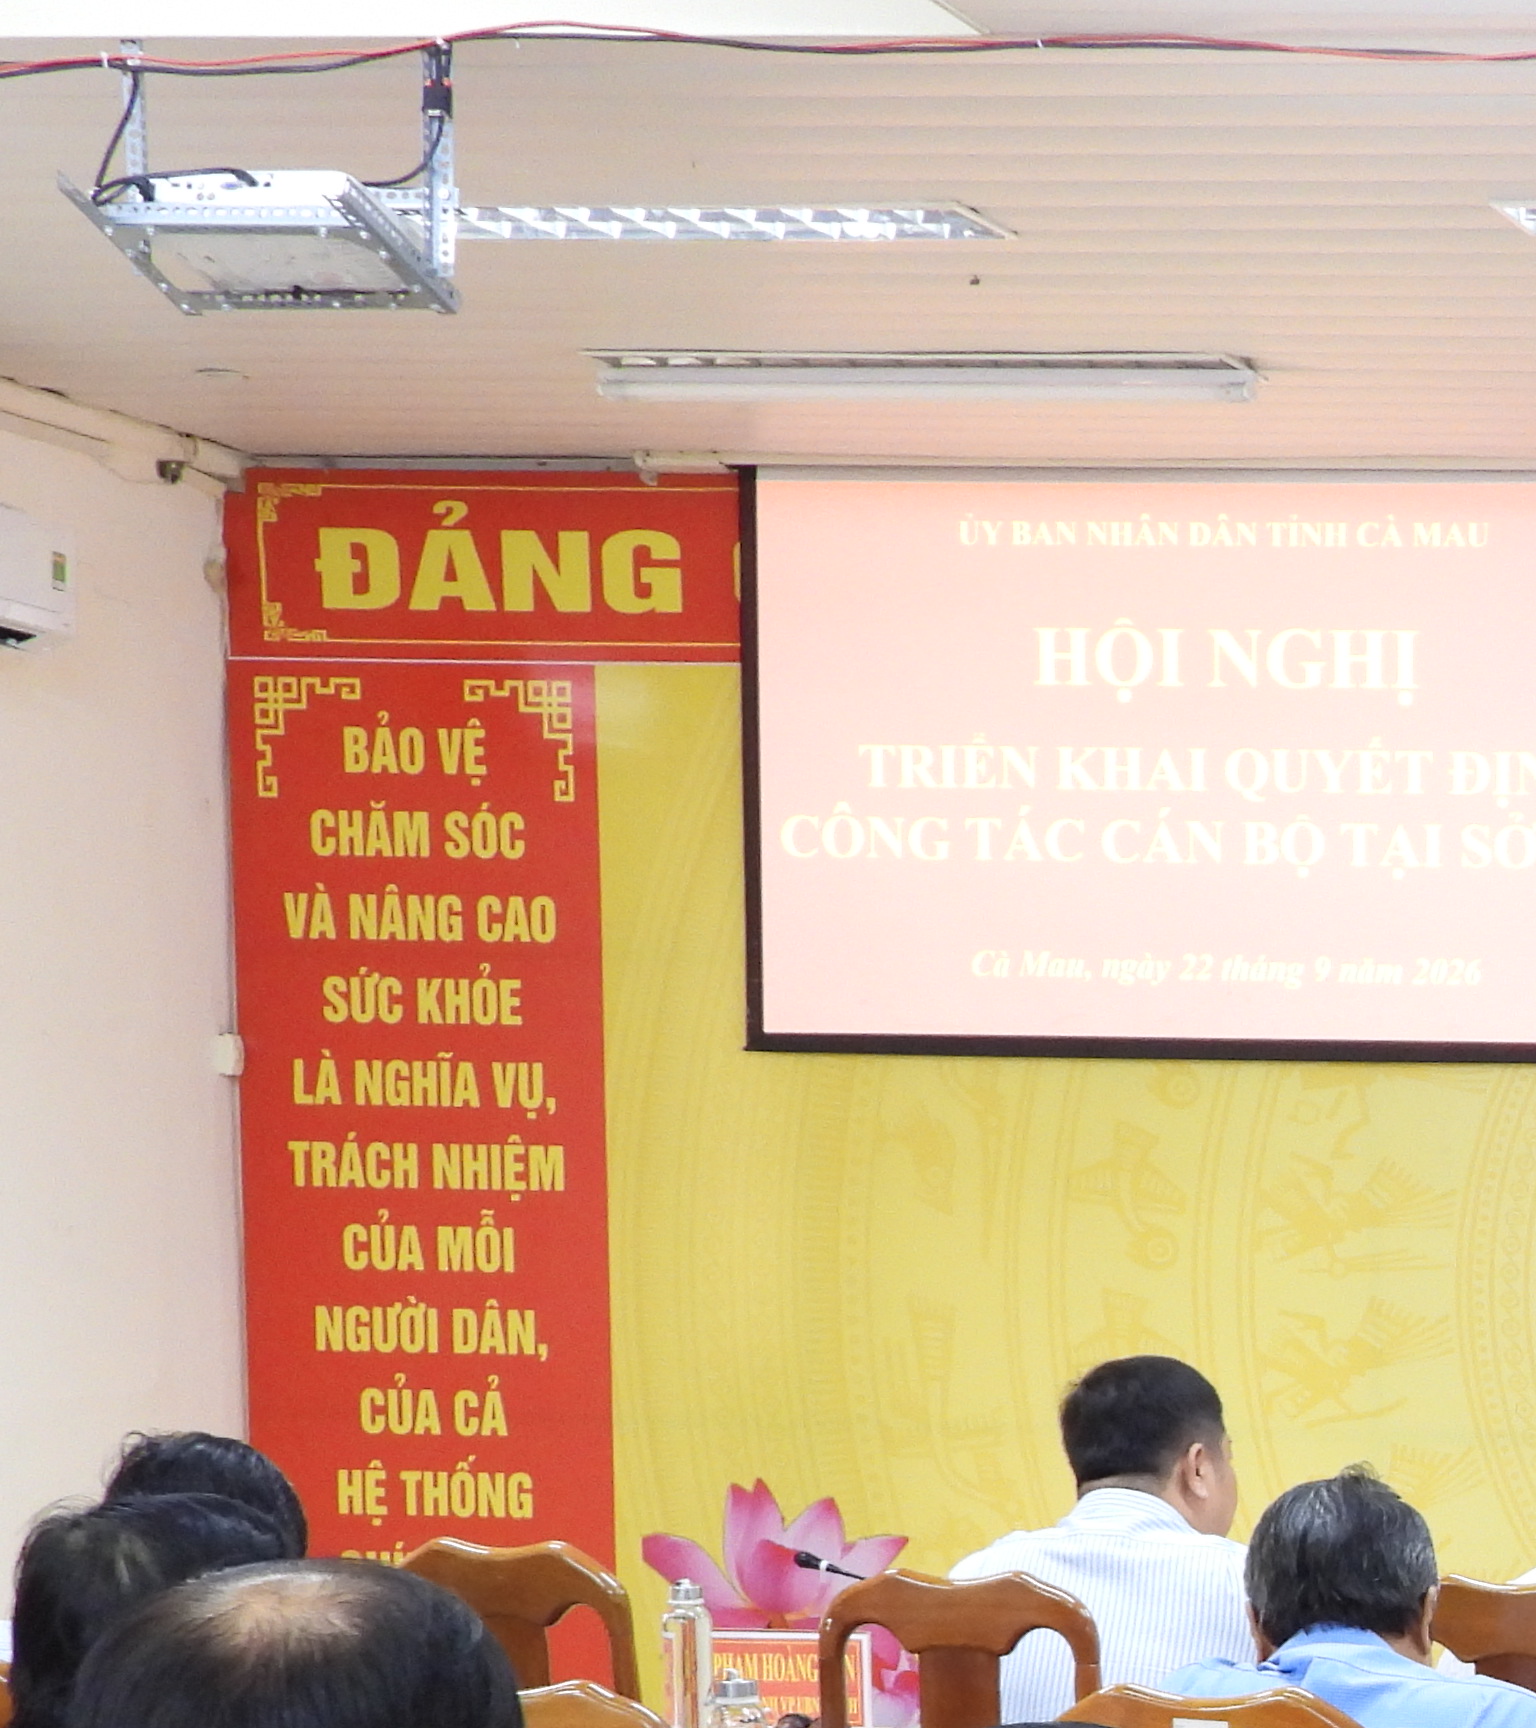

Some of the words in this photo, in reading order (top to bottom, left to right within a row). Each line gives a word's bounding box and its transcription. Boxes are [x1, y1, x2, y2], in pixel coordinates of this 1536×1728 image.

[315, 500, 683, 614] ĐẢNG
[957, 512, 1004, 547] ỦY
[1010, 519, 1078, 547] BAN
[1085, 512, 1179, 548] NHÂN
[1188, 512, 1258, 548] DÂN
[1265, 513, 1348, 548] TỈNH
[1355, 513, 1404, 548] CÀ
[1412, 521, 1490, 549] MAU
[1032, 616, 1185, 704] HỘI
[1206, 627, 1420, 707] NGHỊ
[343, 710, 425, 775] BẢO
[437, 718, 487, 786] VỆ
[857, 732, 1039, 790] TRIỂN
[1056, 745, 1207, 792] KHAI
[1224, 736, 1434, 802] QUYẾT
[310, 800, 430, 857] CHĂM
[444, 802, 525, 860] SÓC
[779, 800, 951, 862] CÔNG
[964, 804, 1085, 863] TÁC
[1100, 806, 1224, 865] CÁN
[1243, 814, 1325, 879] BỘ
[1340, 823, 1441, 880] TẠI
[284, 882, 336, 939] VÀ
[349, 883, 463, 942] NÂNG
[477, 895, 556, 944] CAO
[323, 966, 403, 1024] SỨC
[417, 962, 522, 1026] KHỎE
[970, 949, 1011, 979] Cà
[1018, 949, 1093, 982] Mau,
[1101, 952, 1172, 987] ngày
[1178, 952, 1215, 982] 22
[1220, 954, 1305, 990] tháng
[1314, 955, 1332, 982] 9
[1337, 957, 1403, 985] năm
[1411, 957, 1482, 986] 2026
[291, 1048, 343, 1106] LÀ
[354, 1051, 481, 1108] NGHĨA
[491, 1061, 556, 1119] VỤ,
[288, 1131, 419, 1189] TRÁCH
[432, 1134, 565, 1202] NHIỆM
[343, 1208, 425, 1271] CỦA
[437, 1209, 515, 1273] MỖI
[315, 1295, 439, 1354] NGƯỜI
[452, 1298, 548, 1361] DÂN,
[360, 1372, 441, 1436] CỦA
[454, 1374, 508, 1437] CẢ
[337, 1459, 388, 1526] HỆ
[399, 1455, 534, 1519] THỐNG
[762, 1645, 819, 1682] HOÀNG
